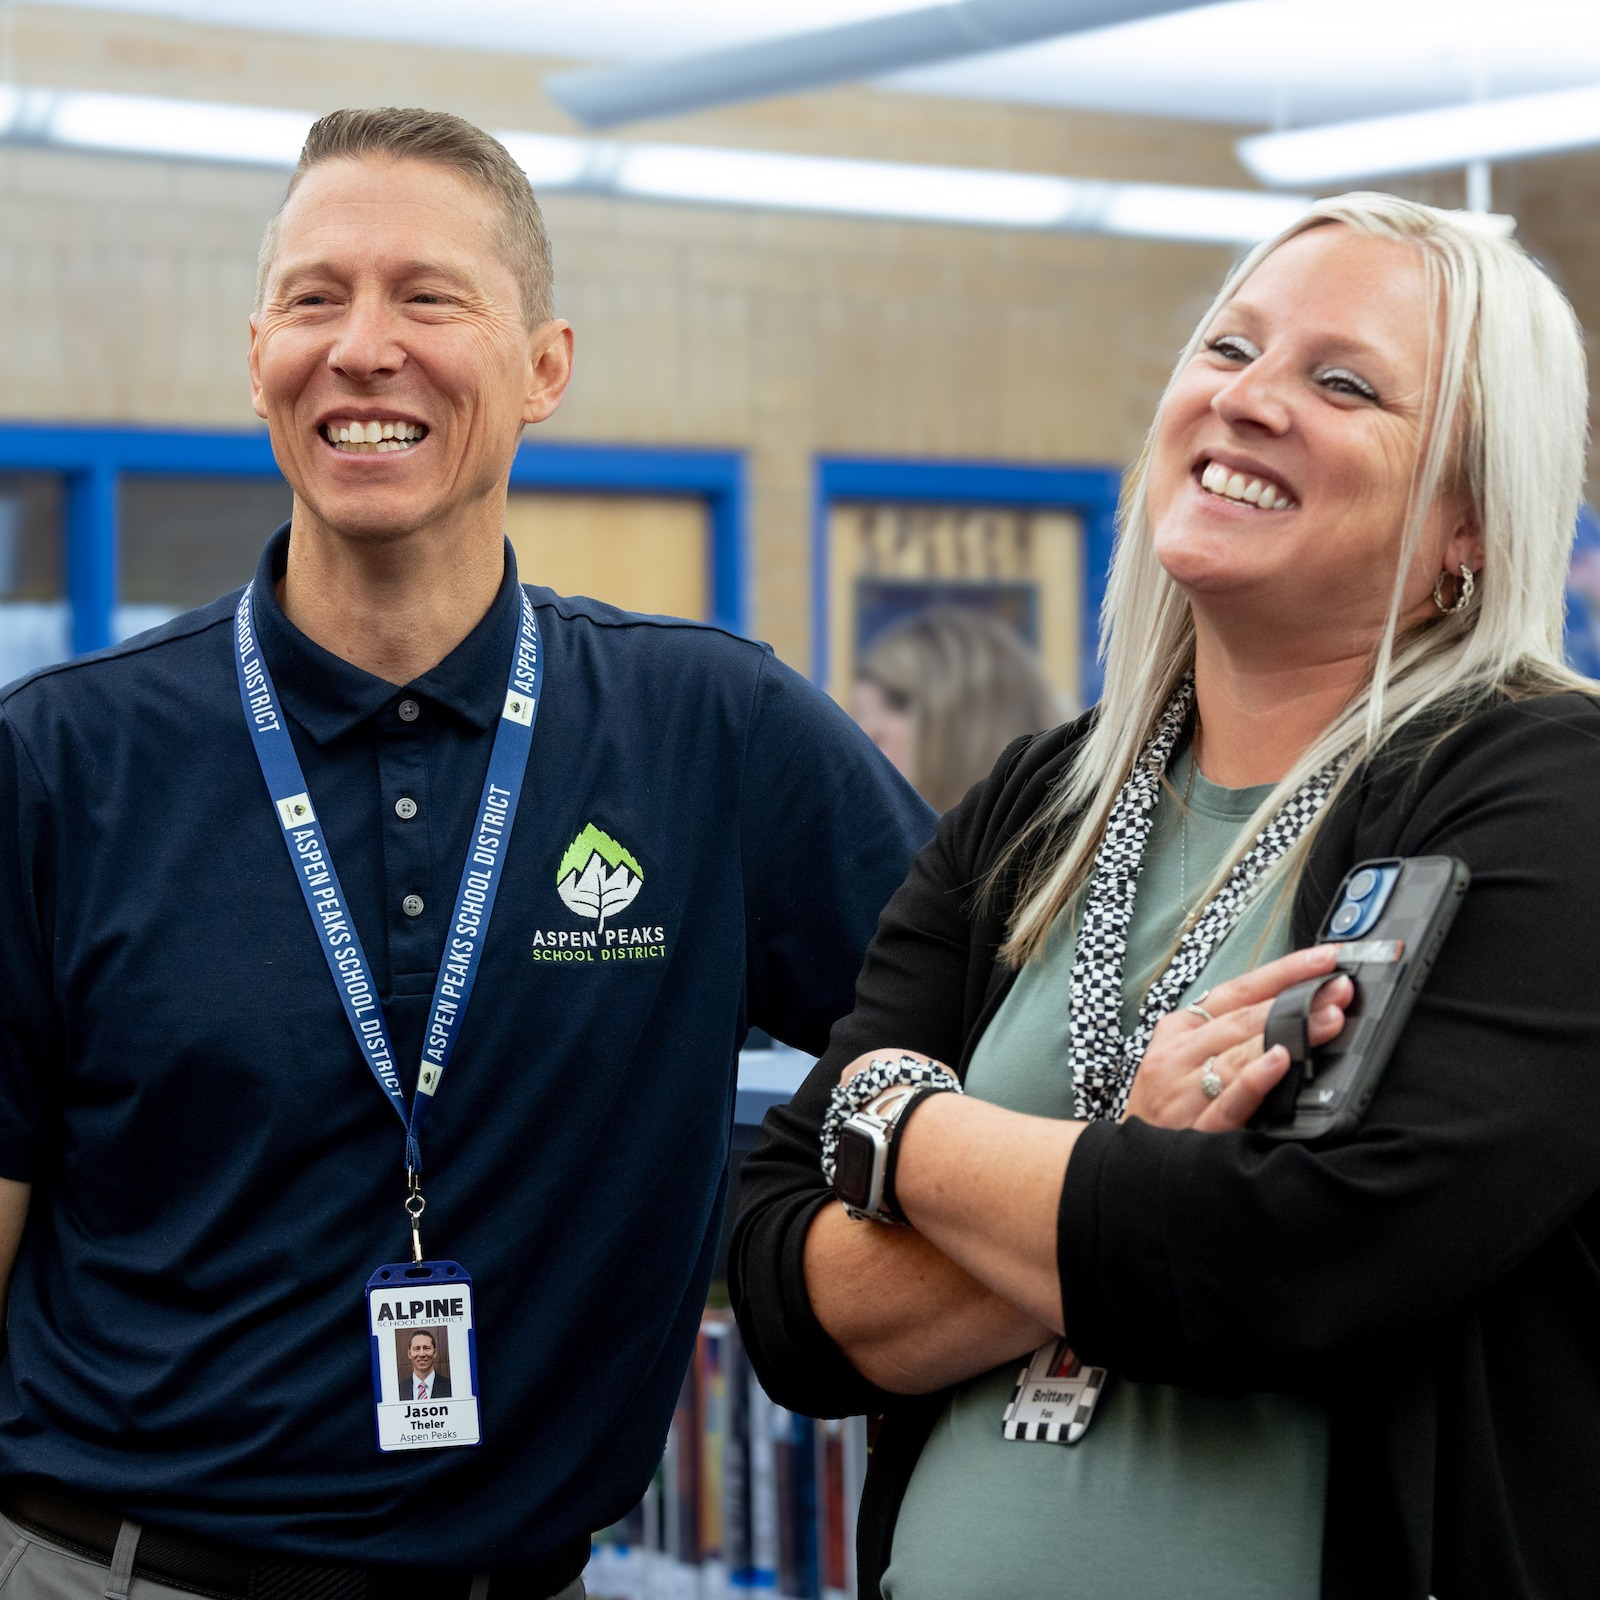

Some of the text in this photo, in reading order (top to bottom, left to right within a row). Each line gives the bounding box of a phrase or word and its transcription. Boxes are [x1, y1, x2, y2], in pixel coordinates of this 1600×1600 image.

[238, 599, 255, 663] SCHOOL
[514, 637, 537, 694] ASPEN
[243, 657, 280, 733] DISTRICT
[427, 783, 511, 1061] ASPEN PEAKS SCHOOL DISTRICT
[532, 926, 665, 948] ASPEN PEAKS
[292, 829, 403, 1098] ASPEN PEAKS SCHOOL DISTRICT
[532, 945, 666, 962] SCHOOL DISTRICT
[377, 1297, 464, 1322] ALPINE
[377, 1316, 463, 1328] SCHOOL DISTRICT
[1032, 1388, 1076, 1407] Brittany
[404, 1405, 449, 1419] Jason
[400, 1429, 458, 1444] Aspen Peaks
[410, 1420, 446, 1431] Theler
